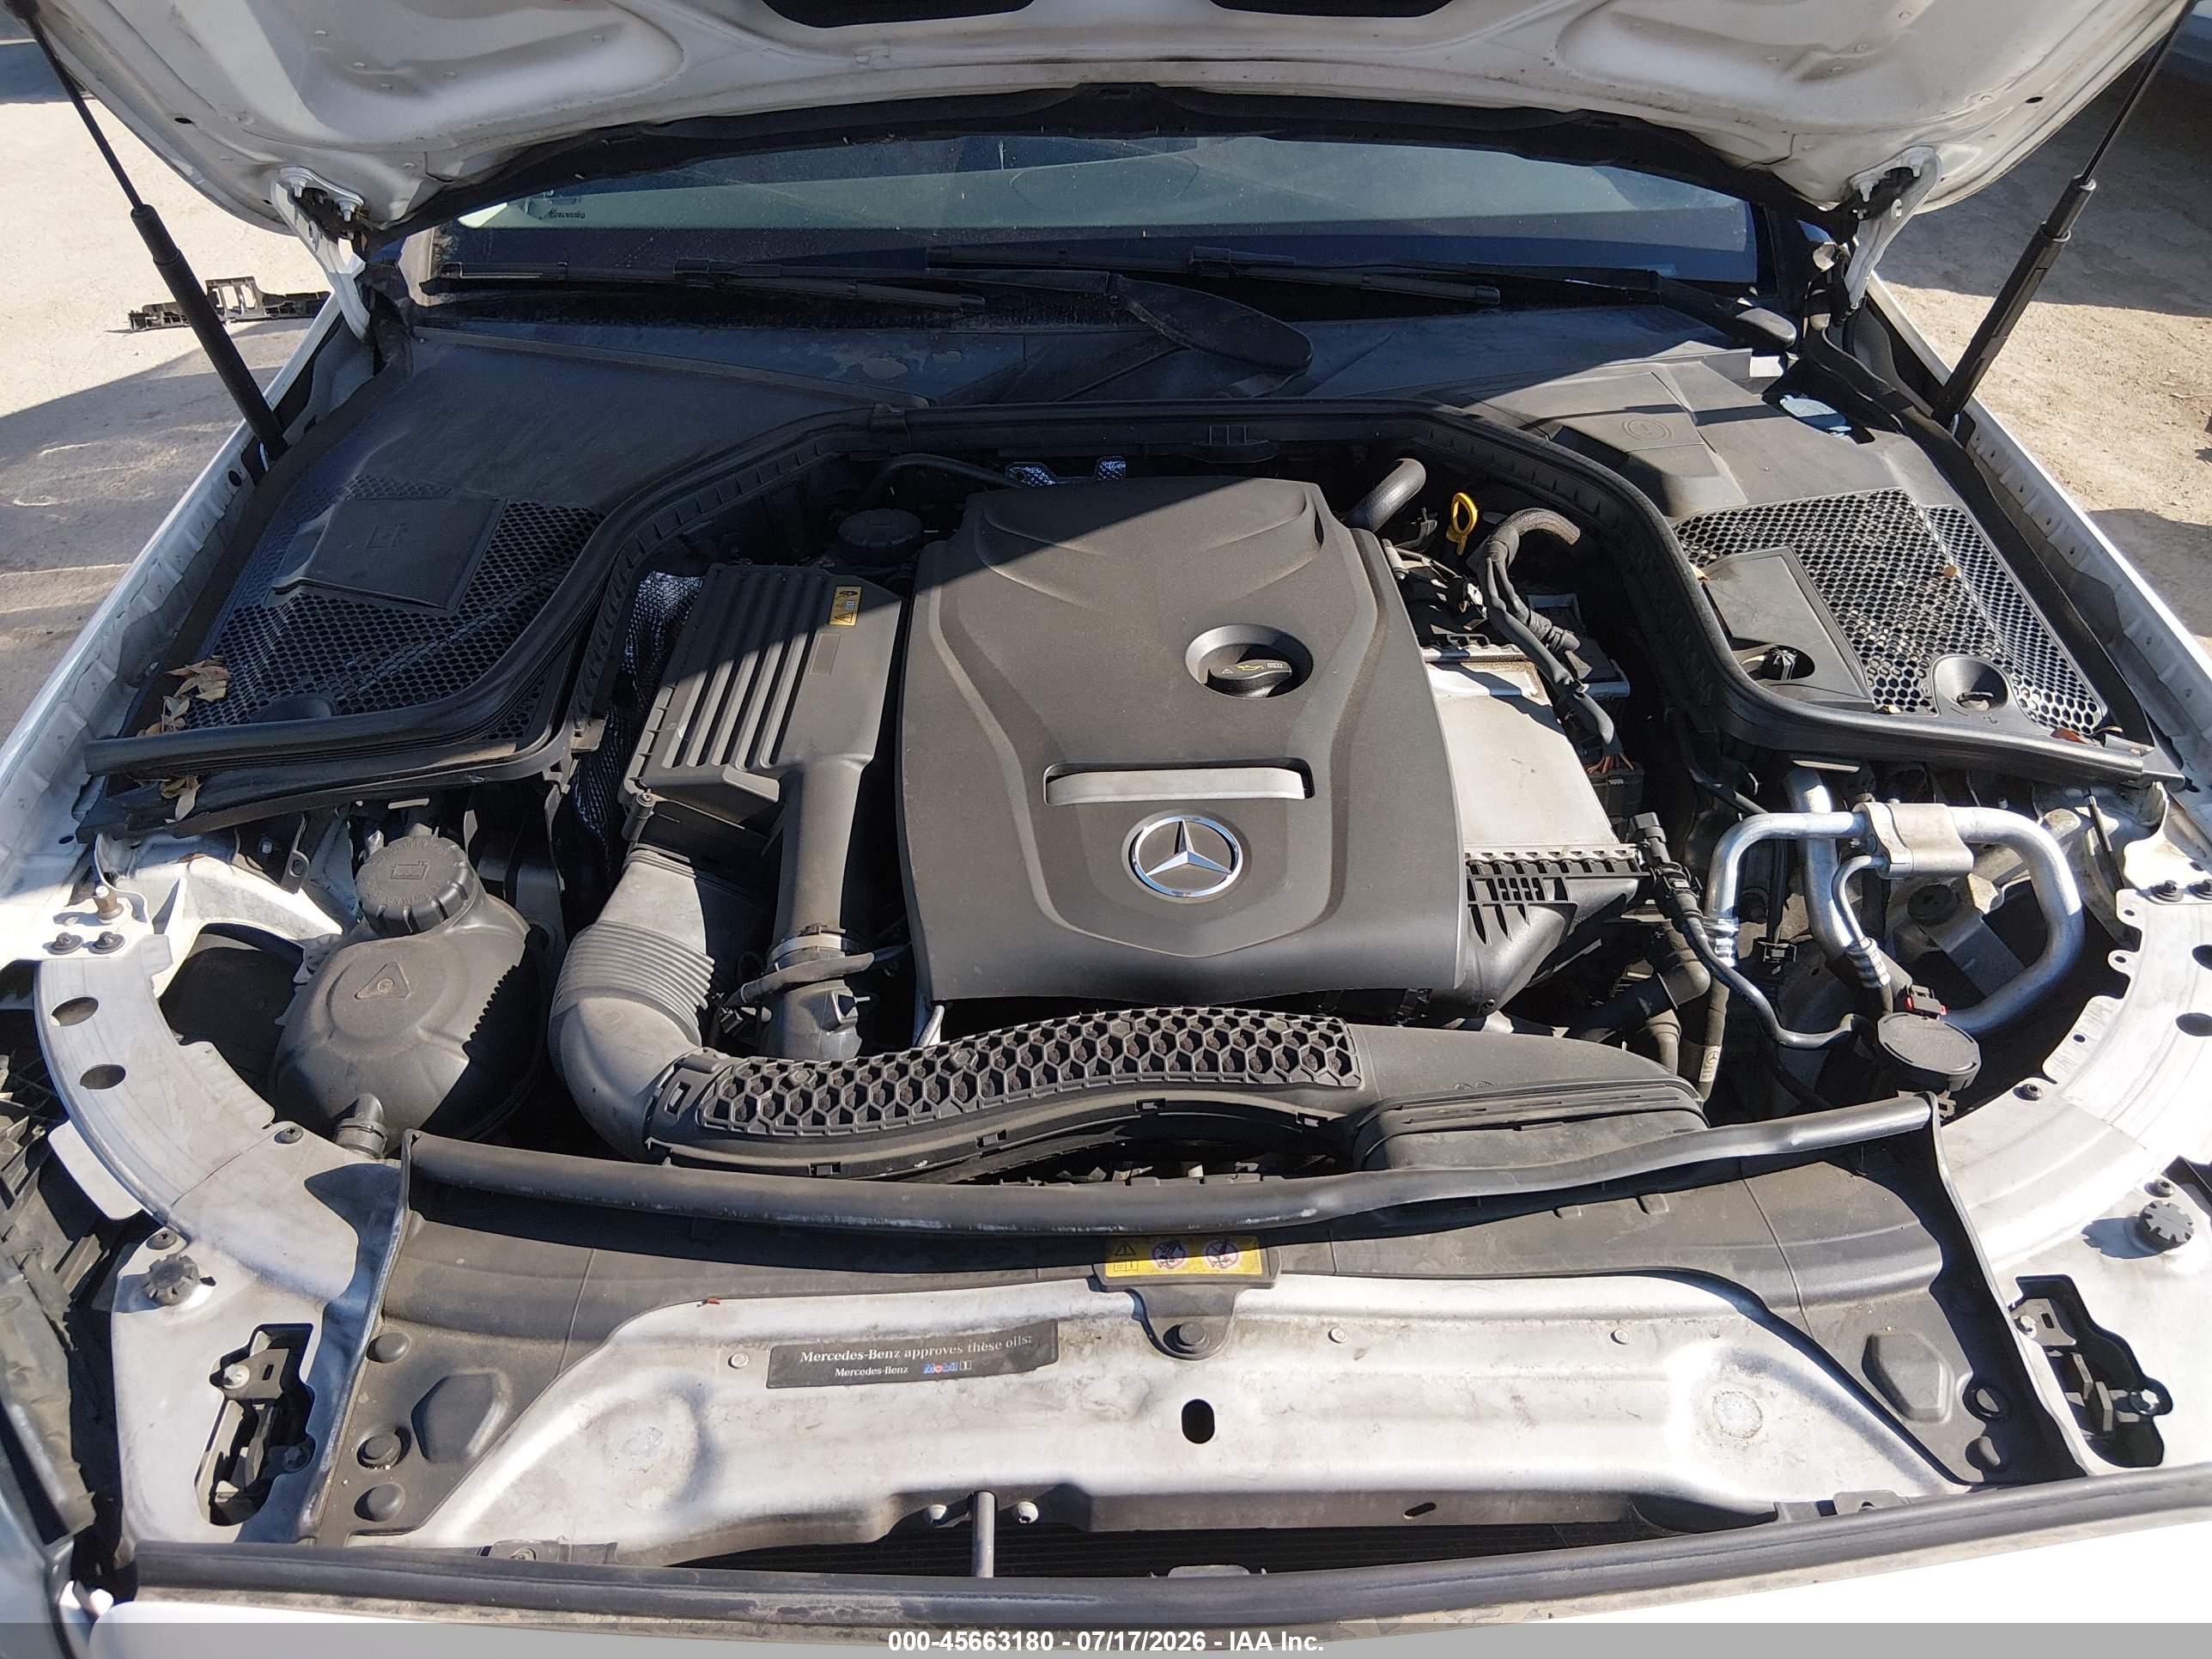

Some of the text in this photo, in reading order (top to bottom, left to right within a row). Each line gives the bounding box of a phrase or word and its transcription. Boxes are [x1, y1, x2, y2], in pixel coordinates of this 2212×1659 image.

[799, 1334, 1032, 1364] Mercedes-Benz approves these oils:
[834, 1365, 909, 1377] Mercedes-Benz
[923, 1361, 958, 1374] Mobil
